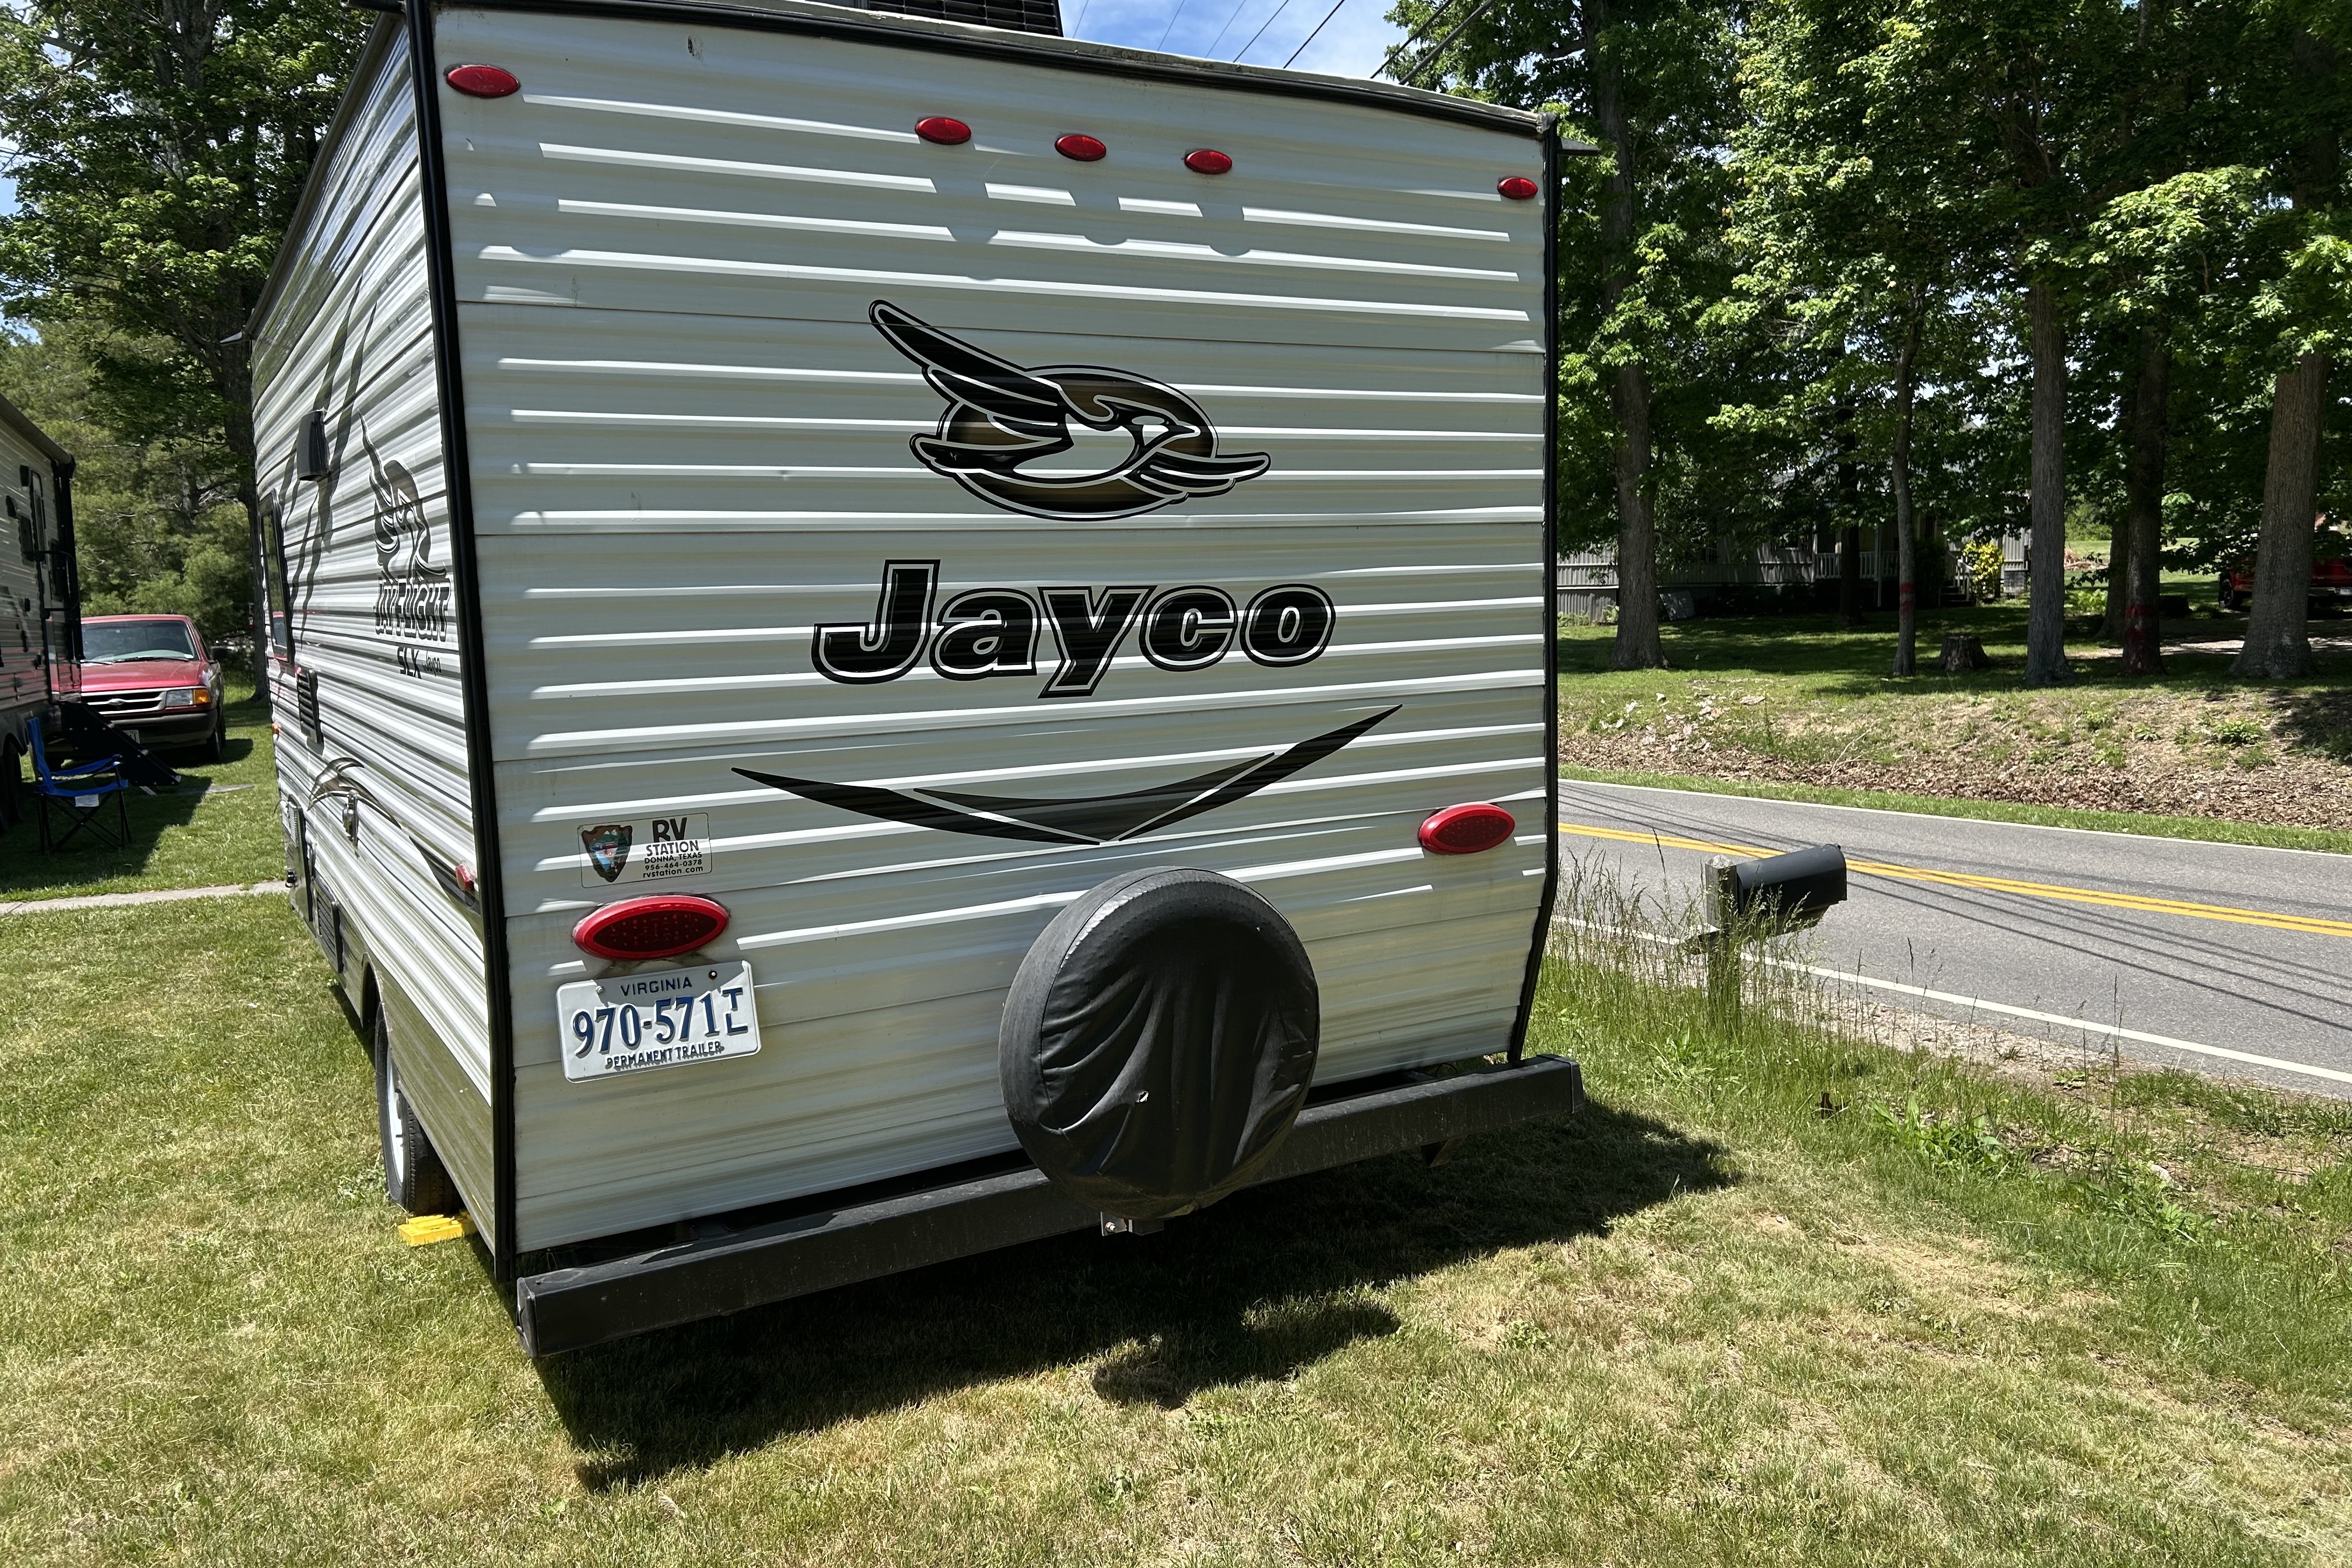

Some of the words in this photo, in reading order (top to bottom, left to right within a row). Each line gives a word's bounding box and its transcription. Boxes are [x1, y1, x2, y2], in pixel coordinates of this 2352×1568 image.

[811, 559, 1336, 699] Jayco
[397, 646, 422, 680] SLK
[652, 817, 687, 843] RV
[644, 855, 677, 864] DONNA,
[678, 851, 702, 860] TEXAS
[646, 839, 699, 857] STATION
[643, 866, 704, 878] rvstation.com
[645, 859, 702, 871] 956-464-0378
[620, 977, 692, 997] VIRGINIA
[606, 1048, 674, 1070] PERMANENT
[674, 1041, 723, 1058] TRAILER
